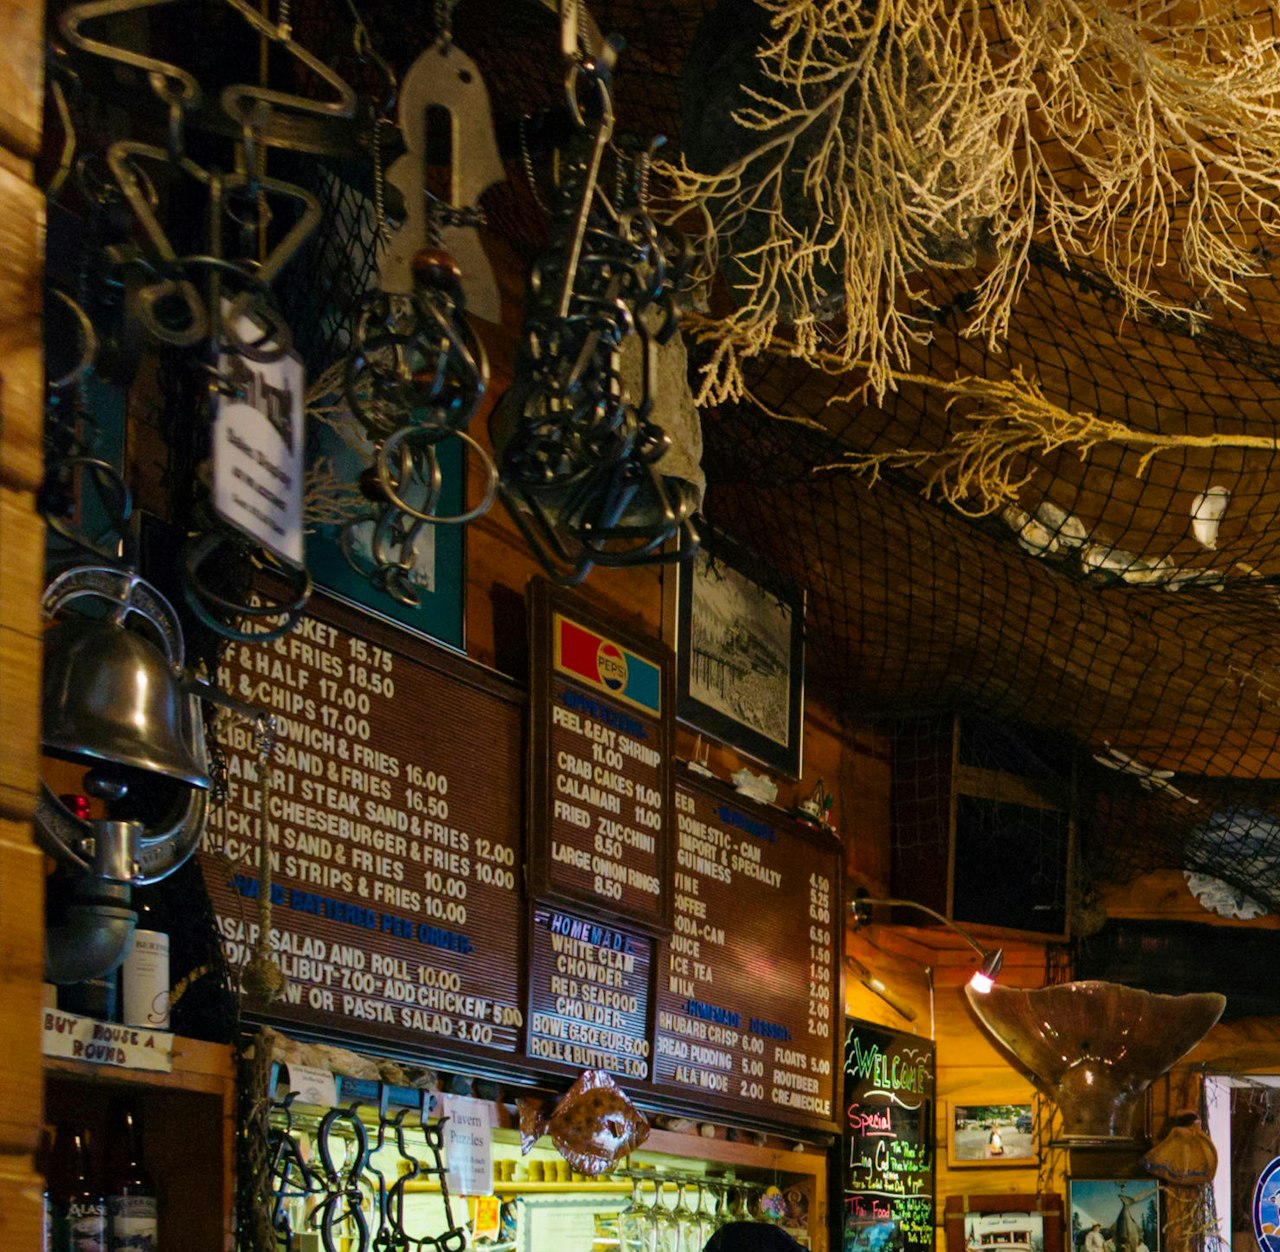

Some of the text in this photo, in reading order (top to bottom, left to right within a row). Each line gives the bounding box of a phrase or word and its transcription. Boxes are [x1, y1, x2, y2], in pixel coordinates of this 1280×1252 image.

[240, 647, 252, 669] &
[256, 652, 309, 690] HALF
[319, 678, 370, 714] 17.00
[291, 640, 343, 677] FRIES
[348, 664, 394, 699] 18.50
[349, 638, 393, 672] 15.75
[598, 655, 628, 677] PEPSI
[240, 674, 252, 697] &
[258, 682, 316, 720] CHIPS
[320, 704, 370, 740] 17.00
[553, 706, 584, 734] PEEL
[618, 736, 661, 769] SHRIMP
[592, 743, 623, 771] 11.00
[273, 743, 449, 820] SAND & FRIES 16.50
[337, 738, 448, 795] & FRIES 16.00
[557, 751, 662, 809] CRAB CAKES 11.00
[302, 781, 515, 867] STEAK SAND & FRIES 12.00
[554, 800, 655, 854] FRIED ZUCCHINI
[556, 774, 662, 830] CALAMARI 11.00
[675, 791, 696, 815] EER
[270, 796, 515, 890] CHEESEBURGER & FRIES 10.00
[283, 828, 467, 899] SAND & FRIES 10.00
[552, 841, 661, 895] LARGE ONION RINGS
[594, 834, 623, 859] 8.50
[678, 814, 732, 850] DOMESTIC
[740, 842, 762, 863] CAN
[809, 872, 830, 893] 4.50
[679, 831, 718, 862] IMPORT
[732, 855, 782, 889] SPECIALTY
[285, 855, 467, 924] STRIPS & FRIES 10.00
[594, 876, 623, 900] 8.50
[677, 849, 831, 924] GUINNESS 6.00
[290, 888, 377, 929] BATTERED
[381, 913, 414, 939] PER
[809, 925, 831, 946] 6.50
[269, 929, 327, 961] SALAD
[330, 944, 365, 969] AND
[371, 954, 412, 981] ROLL
[417, 966, 461, 991] 10.00
[550, 933, 635, 974] WHITE CLAM
[670, 933, 830, 1000] JUICE 2.00
[810, 945, 831, 964] 1.50
[810, 964, 830, 982] 1.50
[551, 975, 638, 1013] RED SEAFOOD
[669, 975, 829, 1038] MILK 2.00
[670, 954, 829, 1020] ICE TEA 2.00
[44, 1012, 78, 1035] BUY
[144, 1034, 155, 1049] A
[309, 988, 334, 1012] OR
[343, 995, 396, 1024] PASTA
[402, 1009, 453, 1036] SALAD
[457, 1019, 493, 1044] 3.00
[659, 1011, 707, 1040] RHUBARB
[741, 1035, 764, 1055] 6.00
[72, 1040, 127, 1064] ROUND
[531, 1037, 564, 1060] ROLL
[573, 1046, 619, 1071] BUTTER
[691, 1046, 732, 1070] PUDDING
[741, 1058, 764, 1078] 5.00
[775, 1048, 830, 1075] FLOATS 5.00
[854, 1036, 926, 1094] WELCOME
[700, 1073, 729, 1093] MODE
[740, 1080, 764, 1100] 2.00
[773, 1069, 820, 1094] ROOTBEER
[450, 1131, 485, 1148] Puzzles
[451, 1109, 482, 1127] Tavern
[847, 1103, 892, 1137] Special
